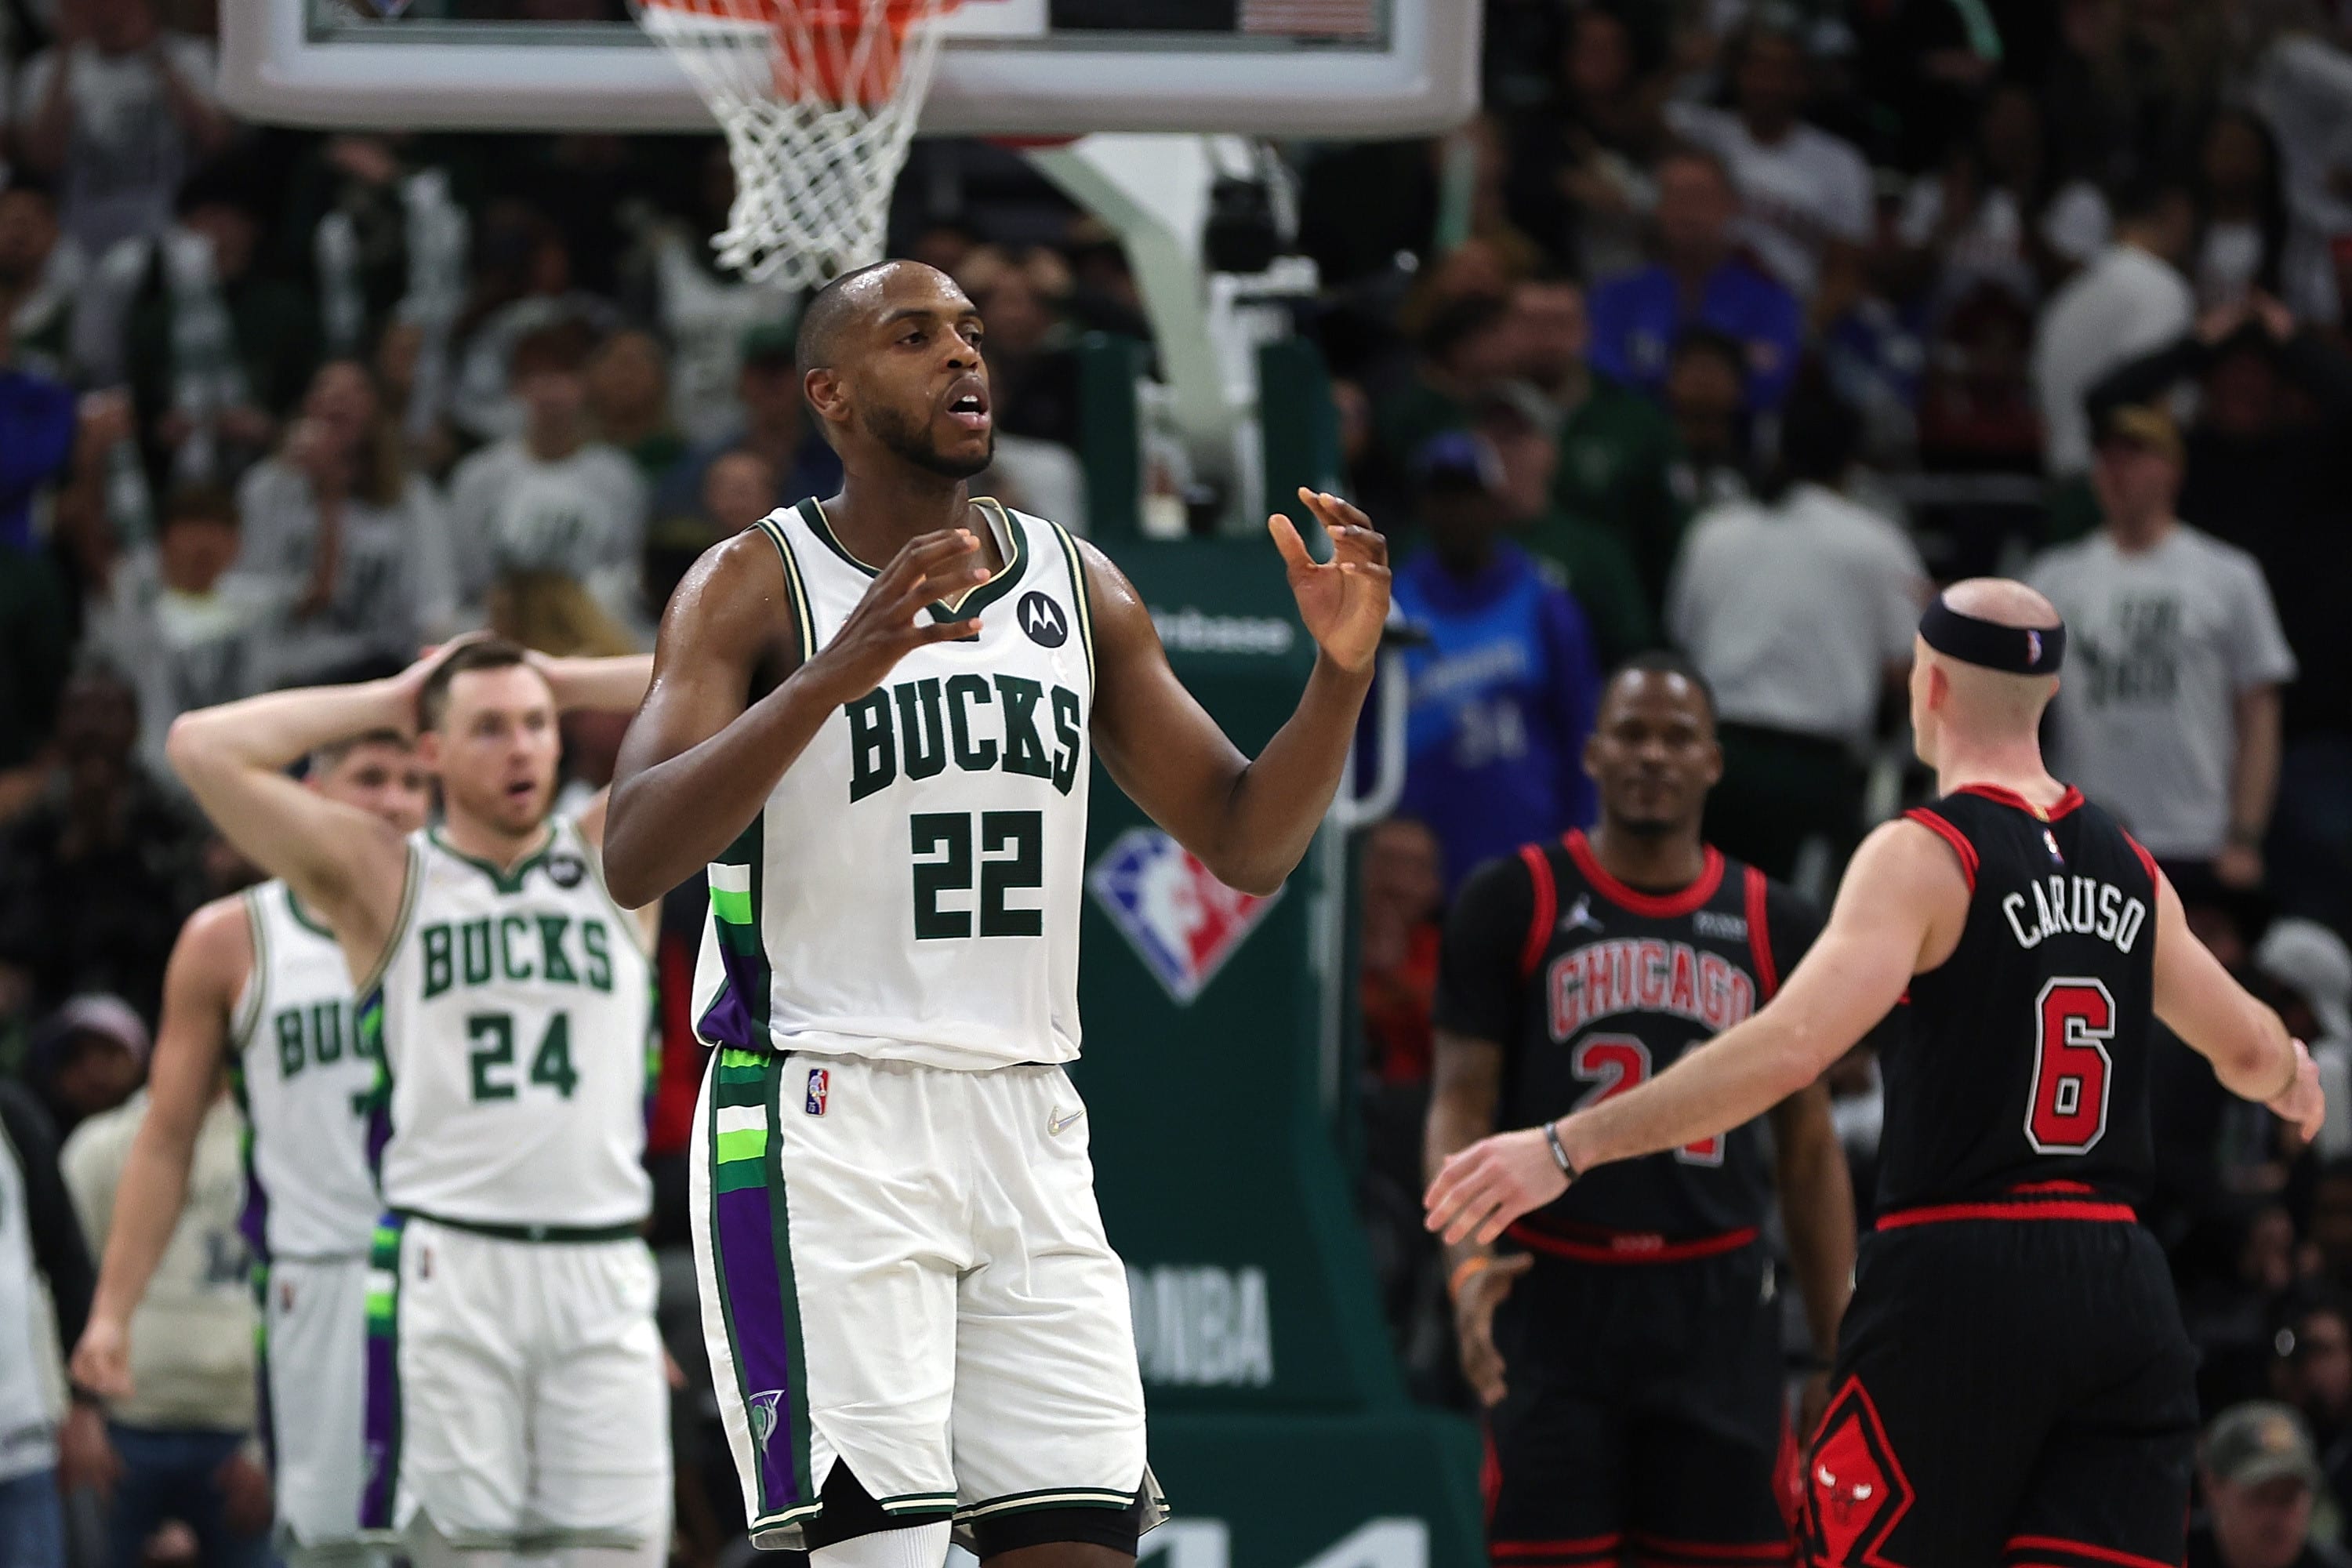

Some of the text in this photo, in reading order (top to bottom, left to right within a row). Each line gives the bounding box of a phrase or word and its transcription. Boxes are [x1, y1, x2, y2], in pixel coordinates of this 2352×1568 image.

[845, 673, 1080, 804] BUCKS
[909, 810, 1043, 940] 22
[2002, 873, 2147, 954] CARUSO
[422, 914, 614, 1000] BUCKS
[1546, 937, 1756, 1044] CHICAGO
[469, 1012, 579, 1102] 24
[2022, 976, 2116, 1156] 6
